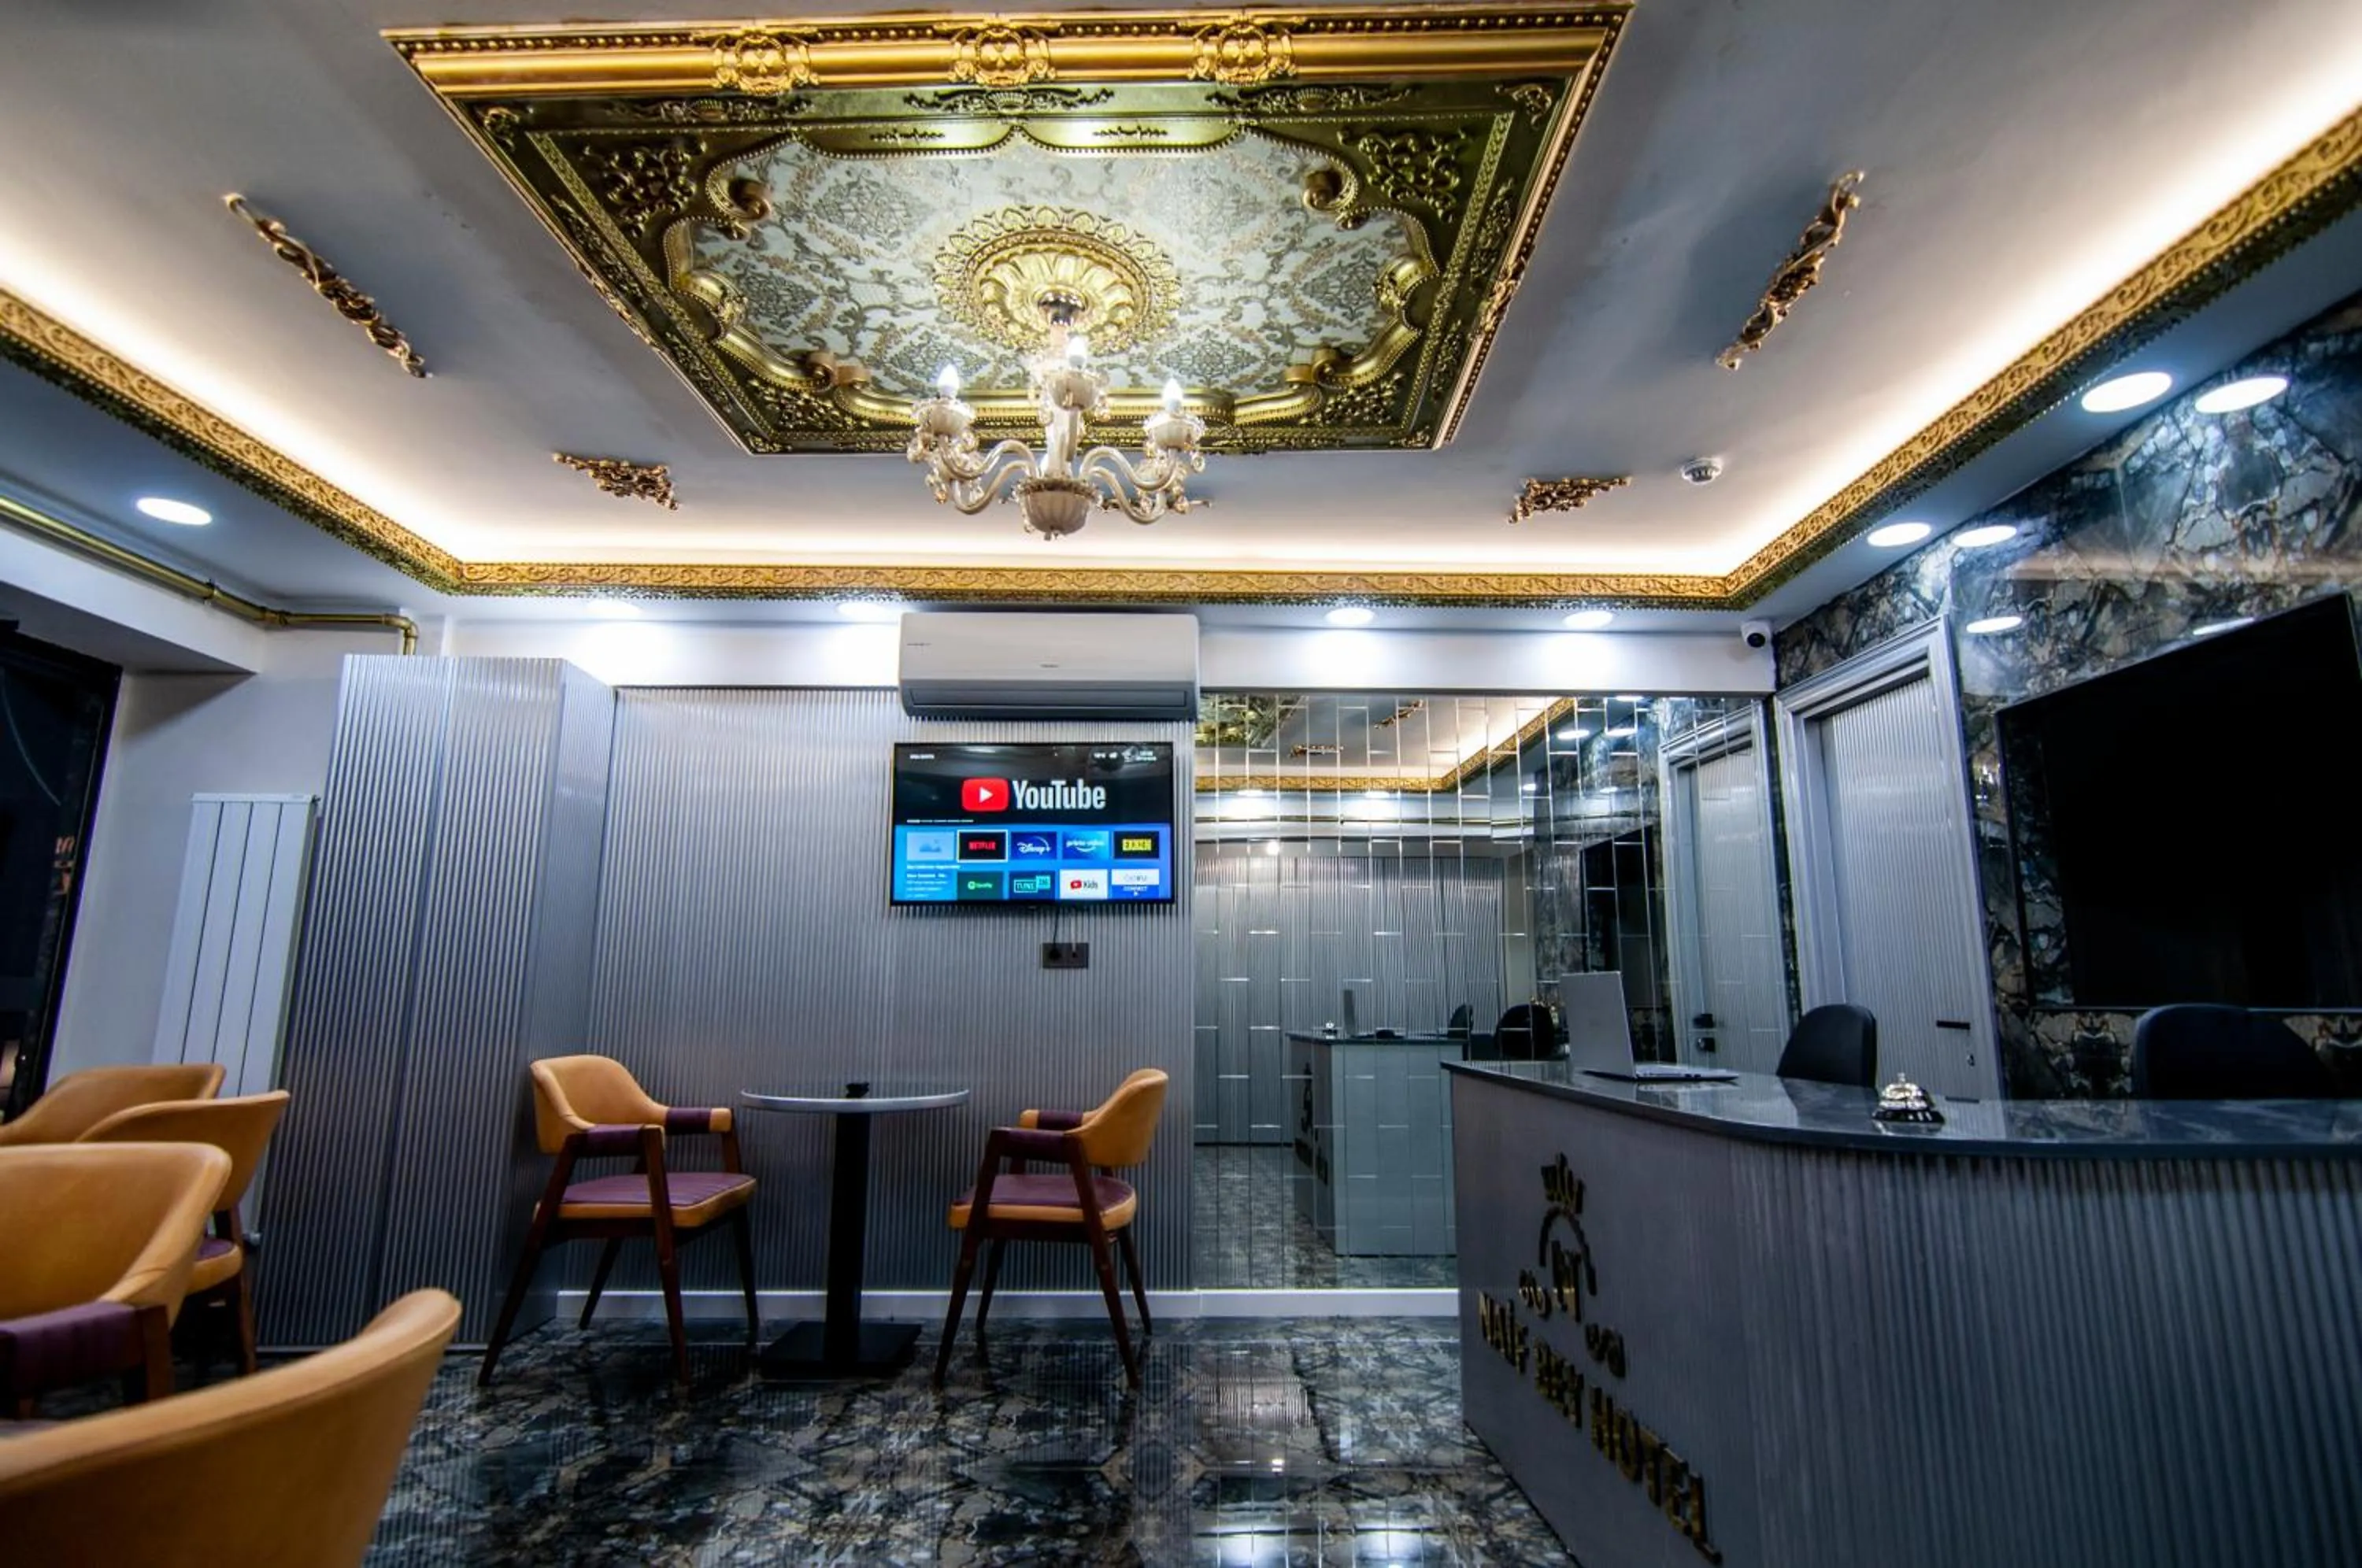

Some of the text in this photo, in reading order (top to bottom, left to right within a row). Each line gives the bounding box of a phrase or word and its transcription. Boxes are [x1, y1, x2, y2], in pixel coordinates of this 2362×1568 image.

[1012, 778, 1106, 810] YouTube
[1083, 879, 1098, 889] Kids
[1590, 1385, 1722, 1566] HOTEL
